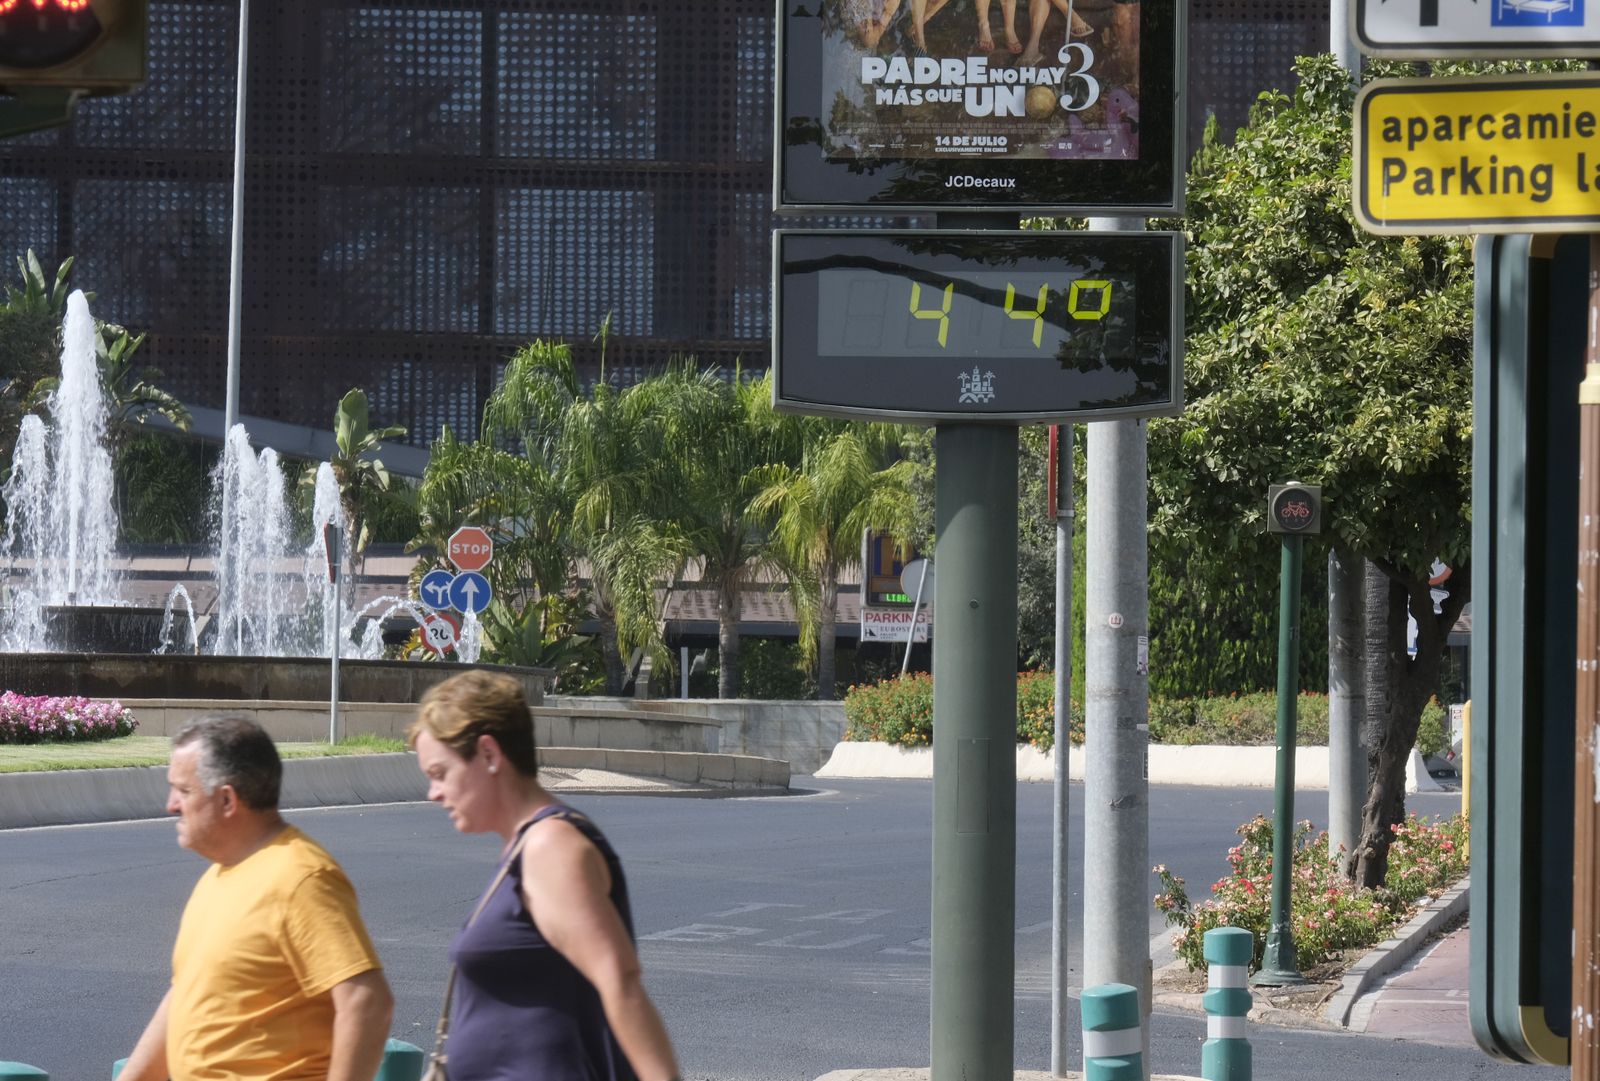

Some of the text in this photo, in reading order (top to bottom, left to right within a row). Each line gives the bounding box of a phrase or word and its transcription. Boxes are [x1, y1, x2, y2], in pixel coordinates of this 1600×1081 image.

[861, 42, 1100, 112] PADRE NO HAY 3
[875, 86, 924, 106] MÁS
[925, 88, 962, 103] QUE
[1382, 102, 1596, 151] aparcamie
[935, 136, 1008, 146] 14 DE JULIO
[944, 175, 1016, 189] JCDecaux
[1382, 155, 1553, 203] Parking
[452, 543, 489, 555] STOP
[865, 612, 926, 624] PARKING
